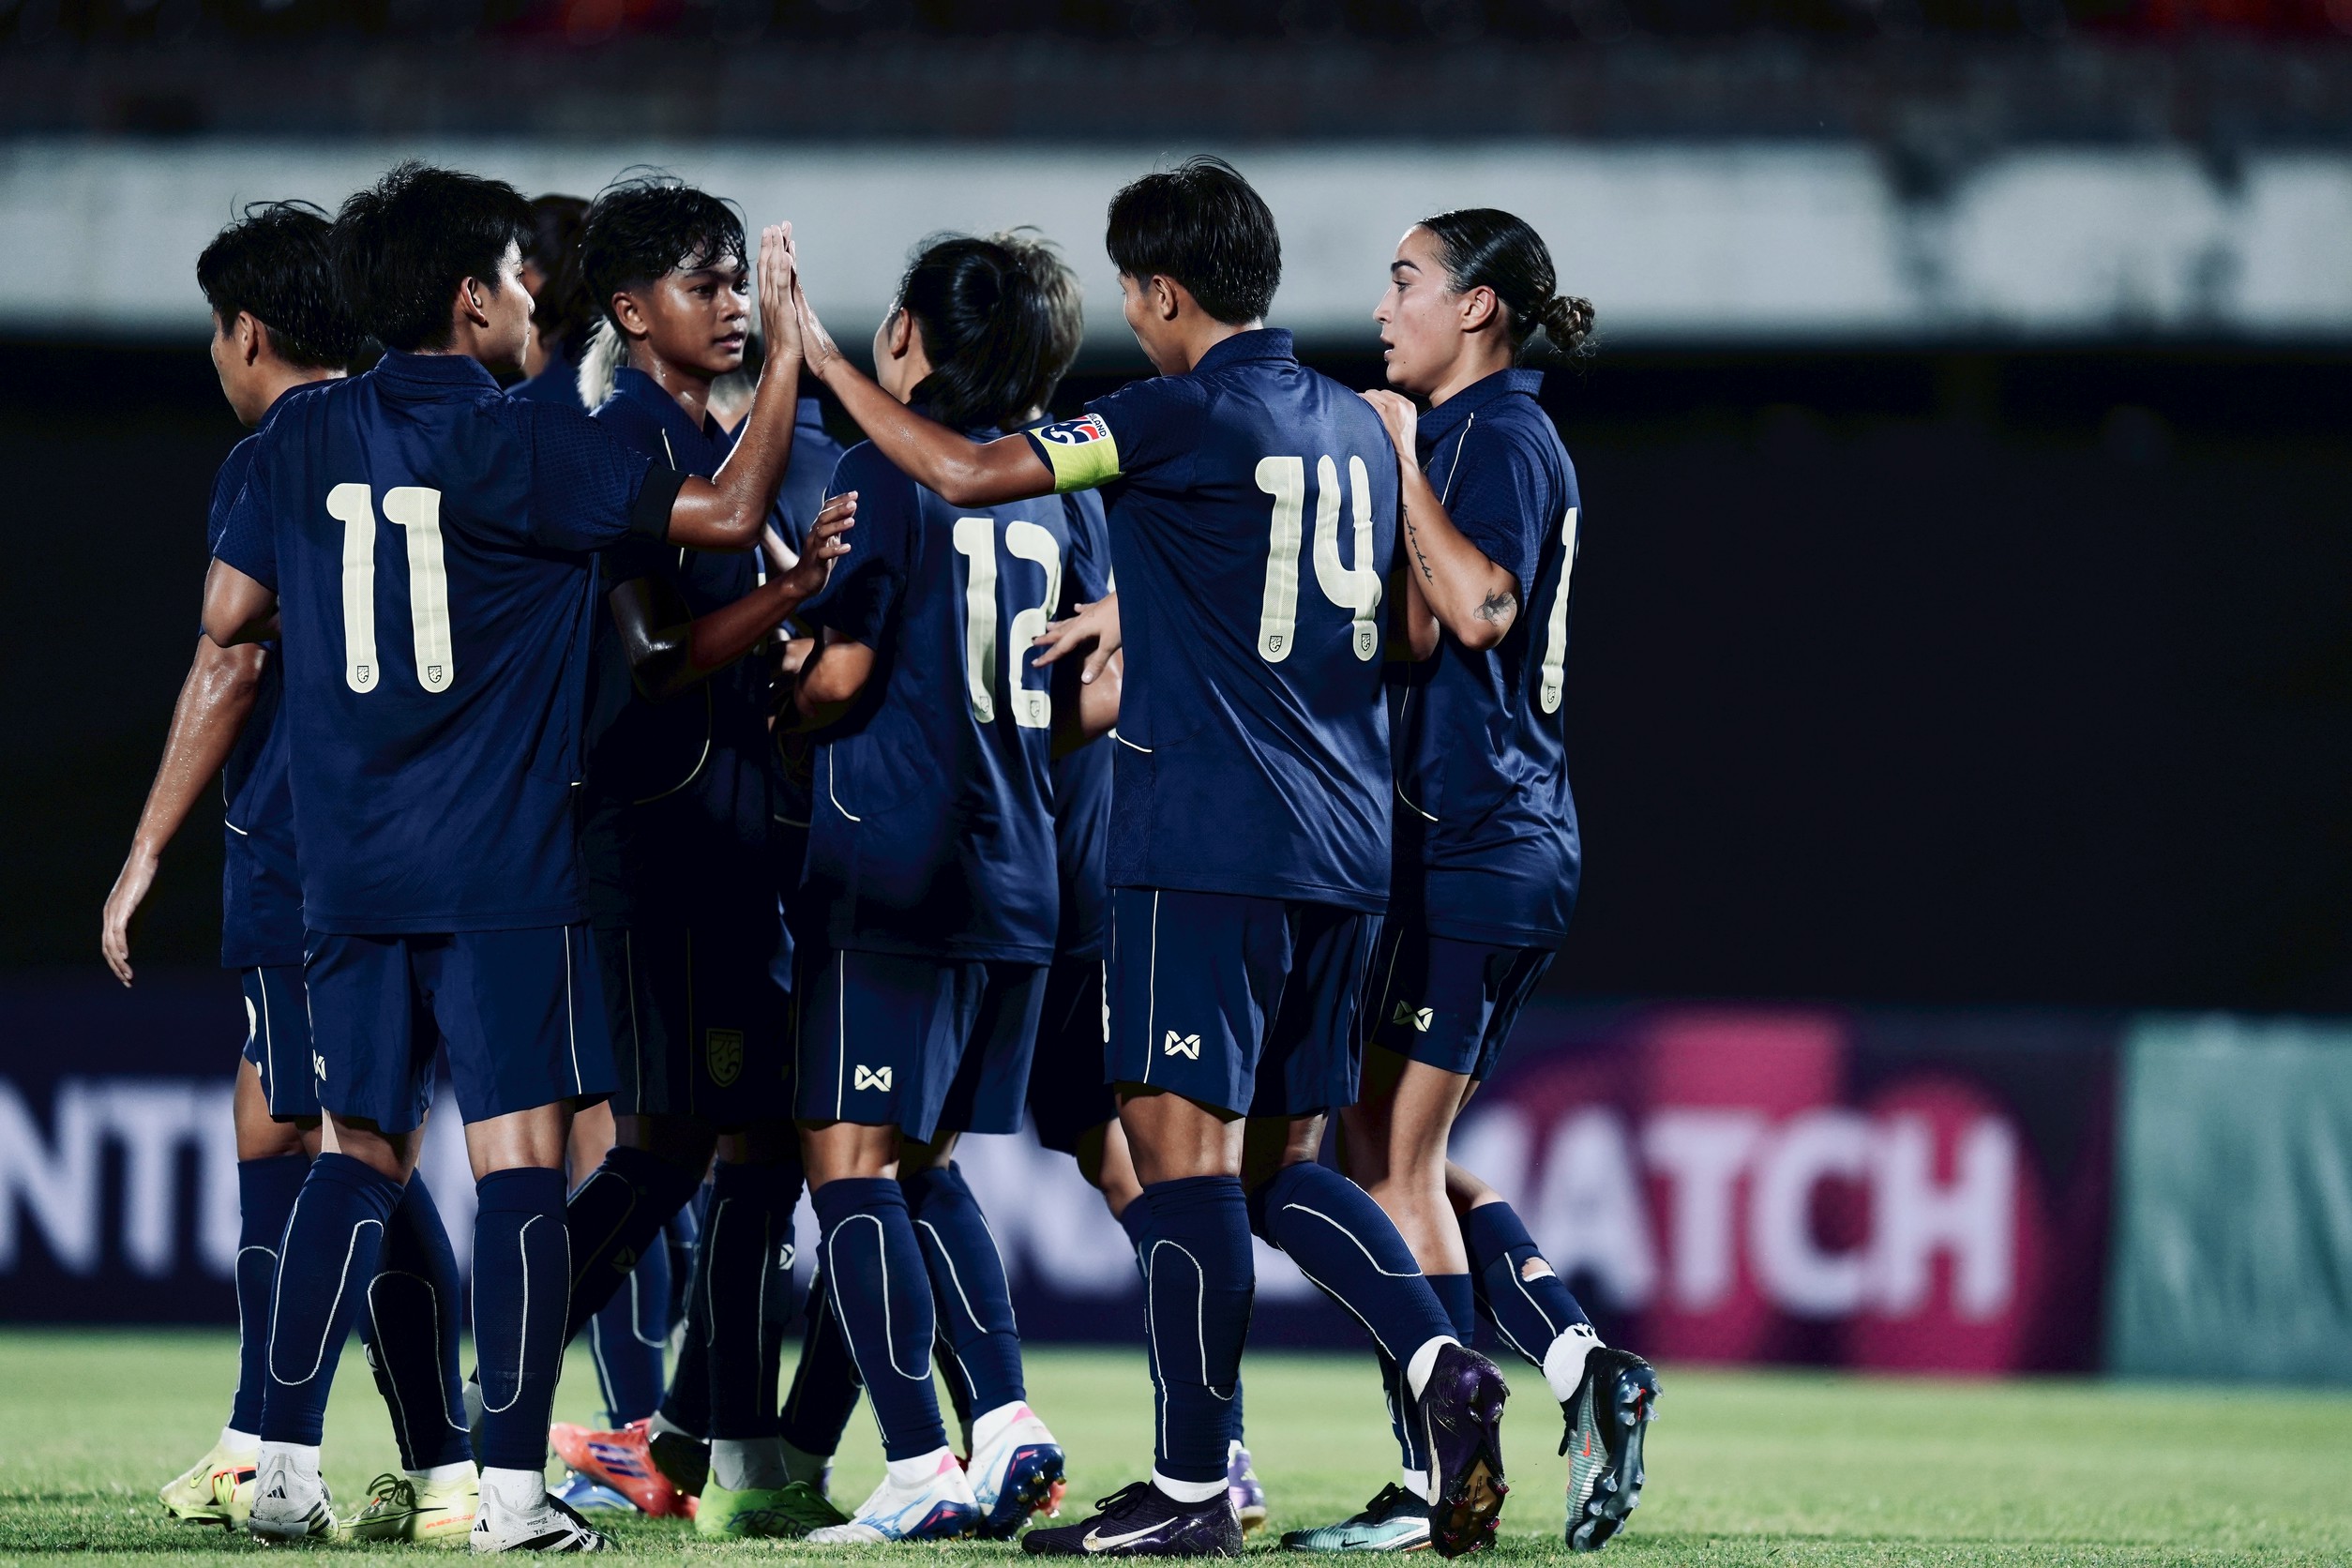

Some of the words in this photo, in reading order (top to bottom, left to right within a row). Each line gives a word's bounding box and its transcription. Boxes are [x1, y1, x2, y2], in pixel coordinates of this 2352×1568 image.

[325, 482, 454, 694] 11
[953, 517, 1062, 729] 12
[1255, 454, 1382, 663] 14
[1541, 507, 1580, 715] 1
